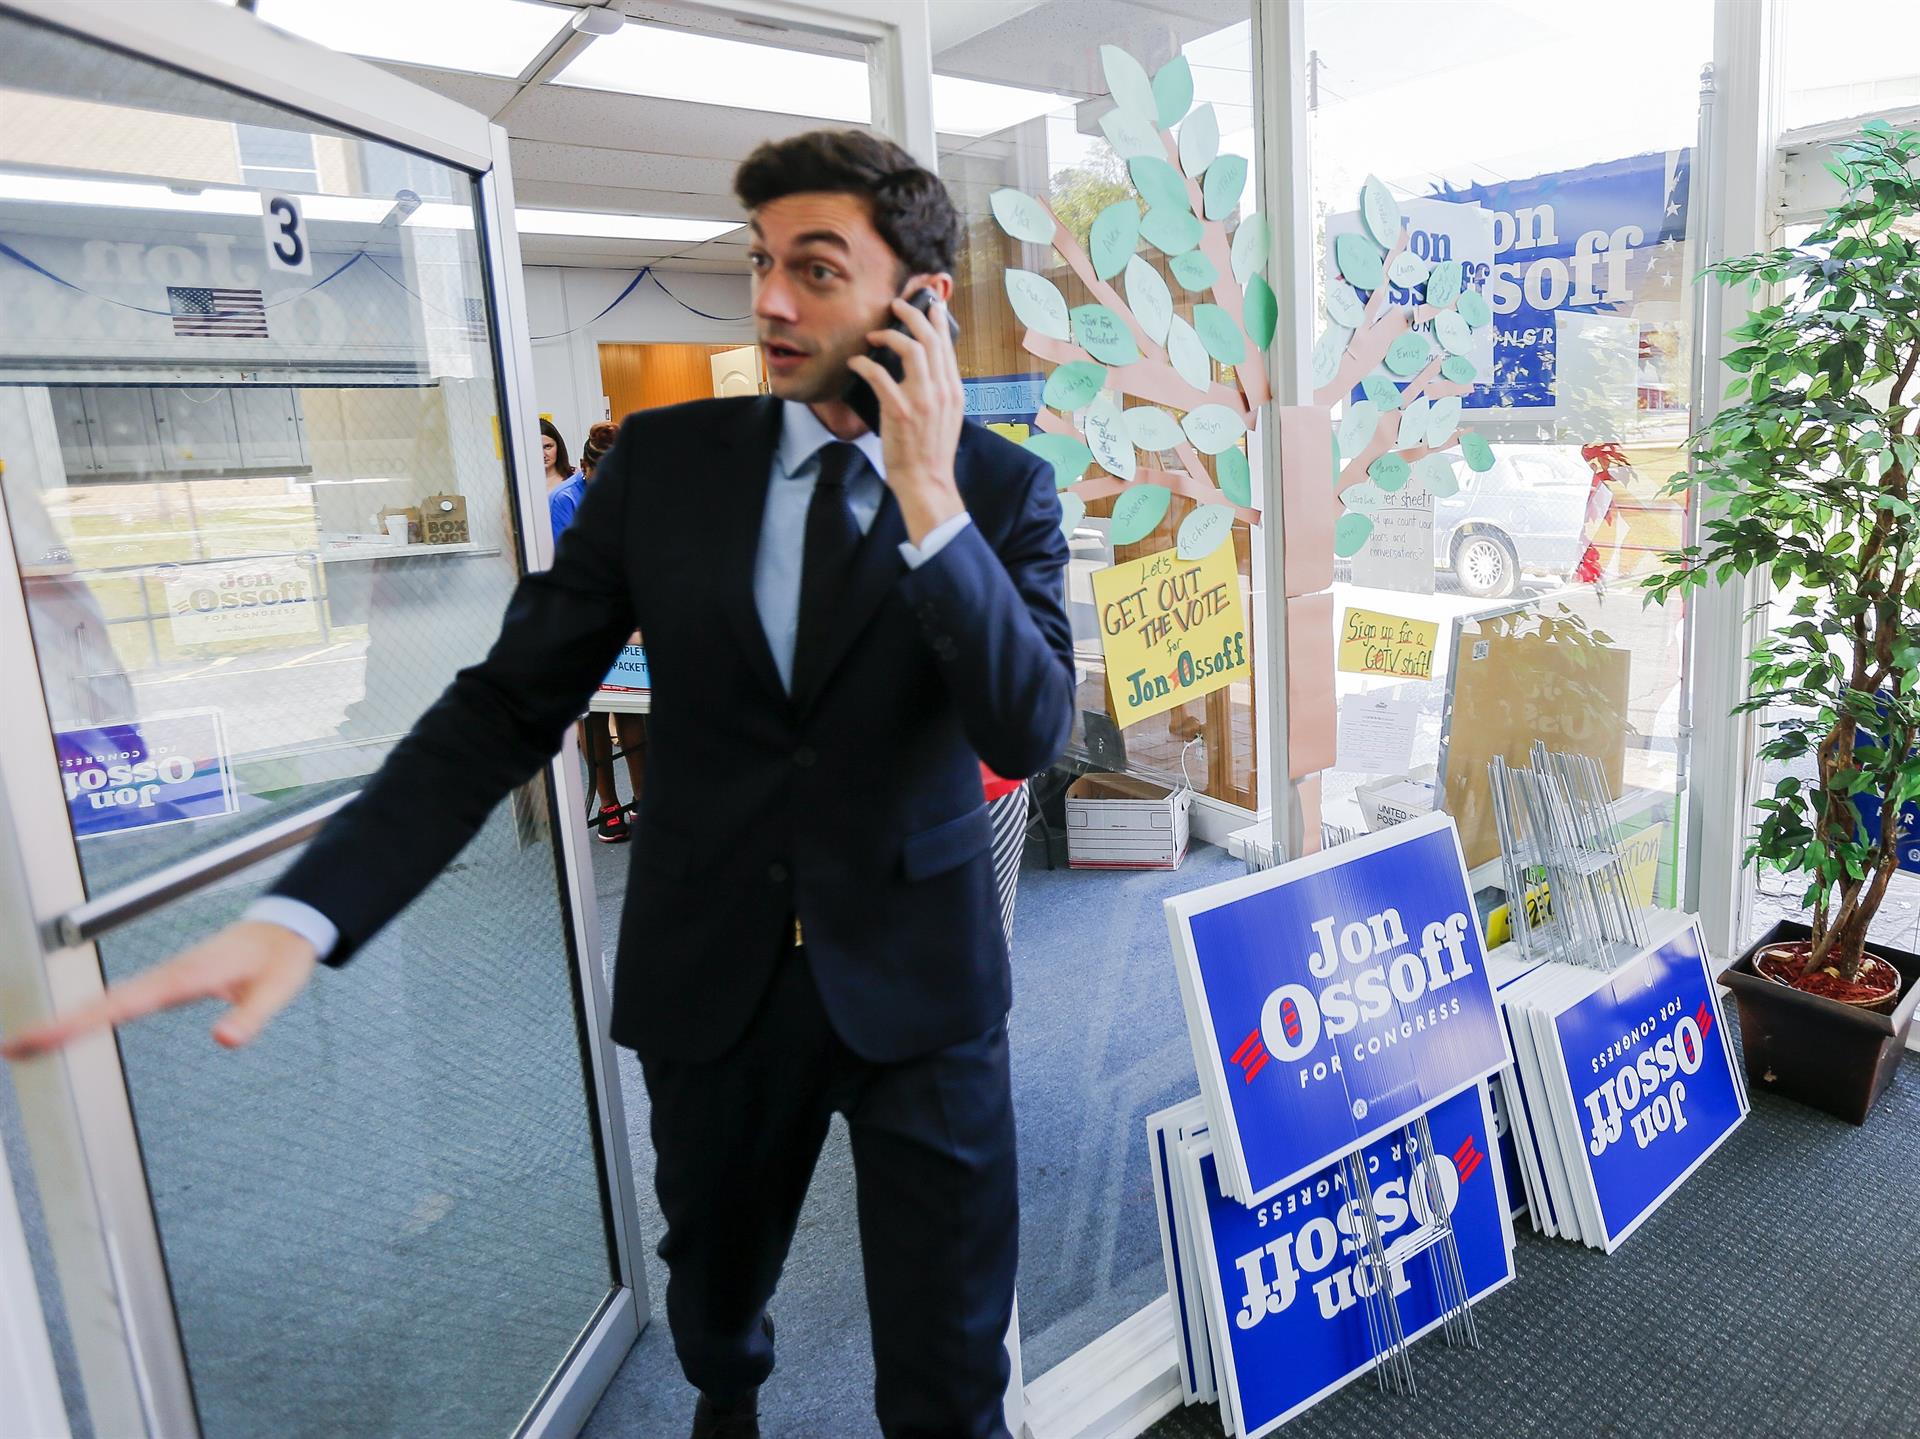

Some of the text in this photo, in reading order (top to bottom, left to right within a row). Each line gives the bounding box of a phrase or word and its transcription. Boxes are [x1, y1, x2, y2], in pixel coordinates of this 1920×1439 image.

[269, 196, 304, 267] 3
[1015, 278, 1062, 320] Charlie
[1493, 225, 1644, 315] soff
[428, 520, 467, 534] BOX
[1180, 512, 1219, 554] Richard
[189, 580, 309, 613] Ossoff
[219, 572, 275, 590] Jon
[1103, 566, 1202, 636] GET OUT
[1141, 556, 1173, 585] Let's
[1138, 582, 1231, 649] THE VOTE
[1166, 638, 1183, 656] for
[1347, 612, 1377, 647] Sign
[1381, 625, 1394, 648] up
[1399, 621, 1413, 644] for
[1126, 631, 1246, 708] Jon Ossoff
[1365, 645, 1433, 677] GOTV shift!
[88, 784, 161, 809] Jon
[1378, 803, 1407, 820] UNITED
[1308, 907, 1409, 979] Jon
[1260, 912, 1474, 1063] Ossoff
[1300, 998, 1461, 1089] FOR CONGRESS
[1591, 996, 1682, 1074] FOR CONGRESS
[1583, 1015, 1704, 1157] Ossoff
[1630, 1080, 1688, 1149] Jon
[1257, 1155, 1380, 1228] CNGRESS
[1235, 1154, 1459, 1330] Ossoff
